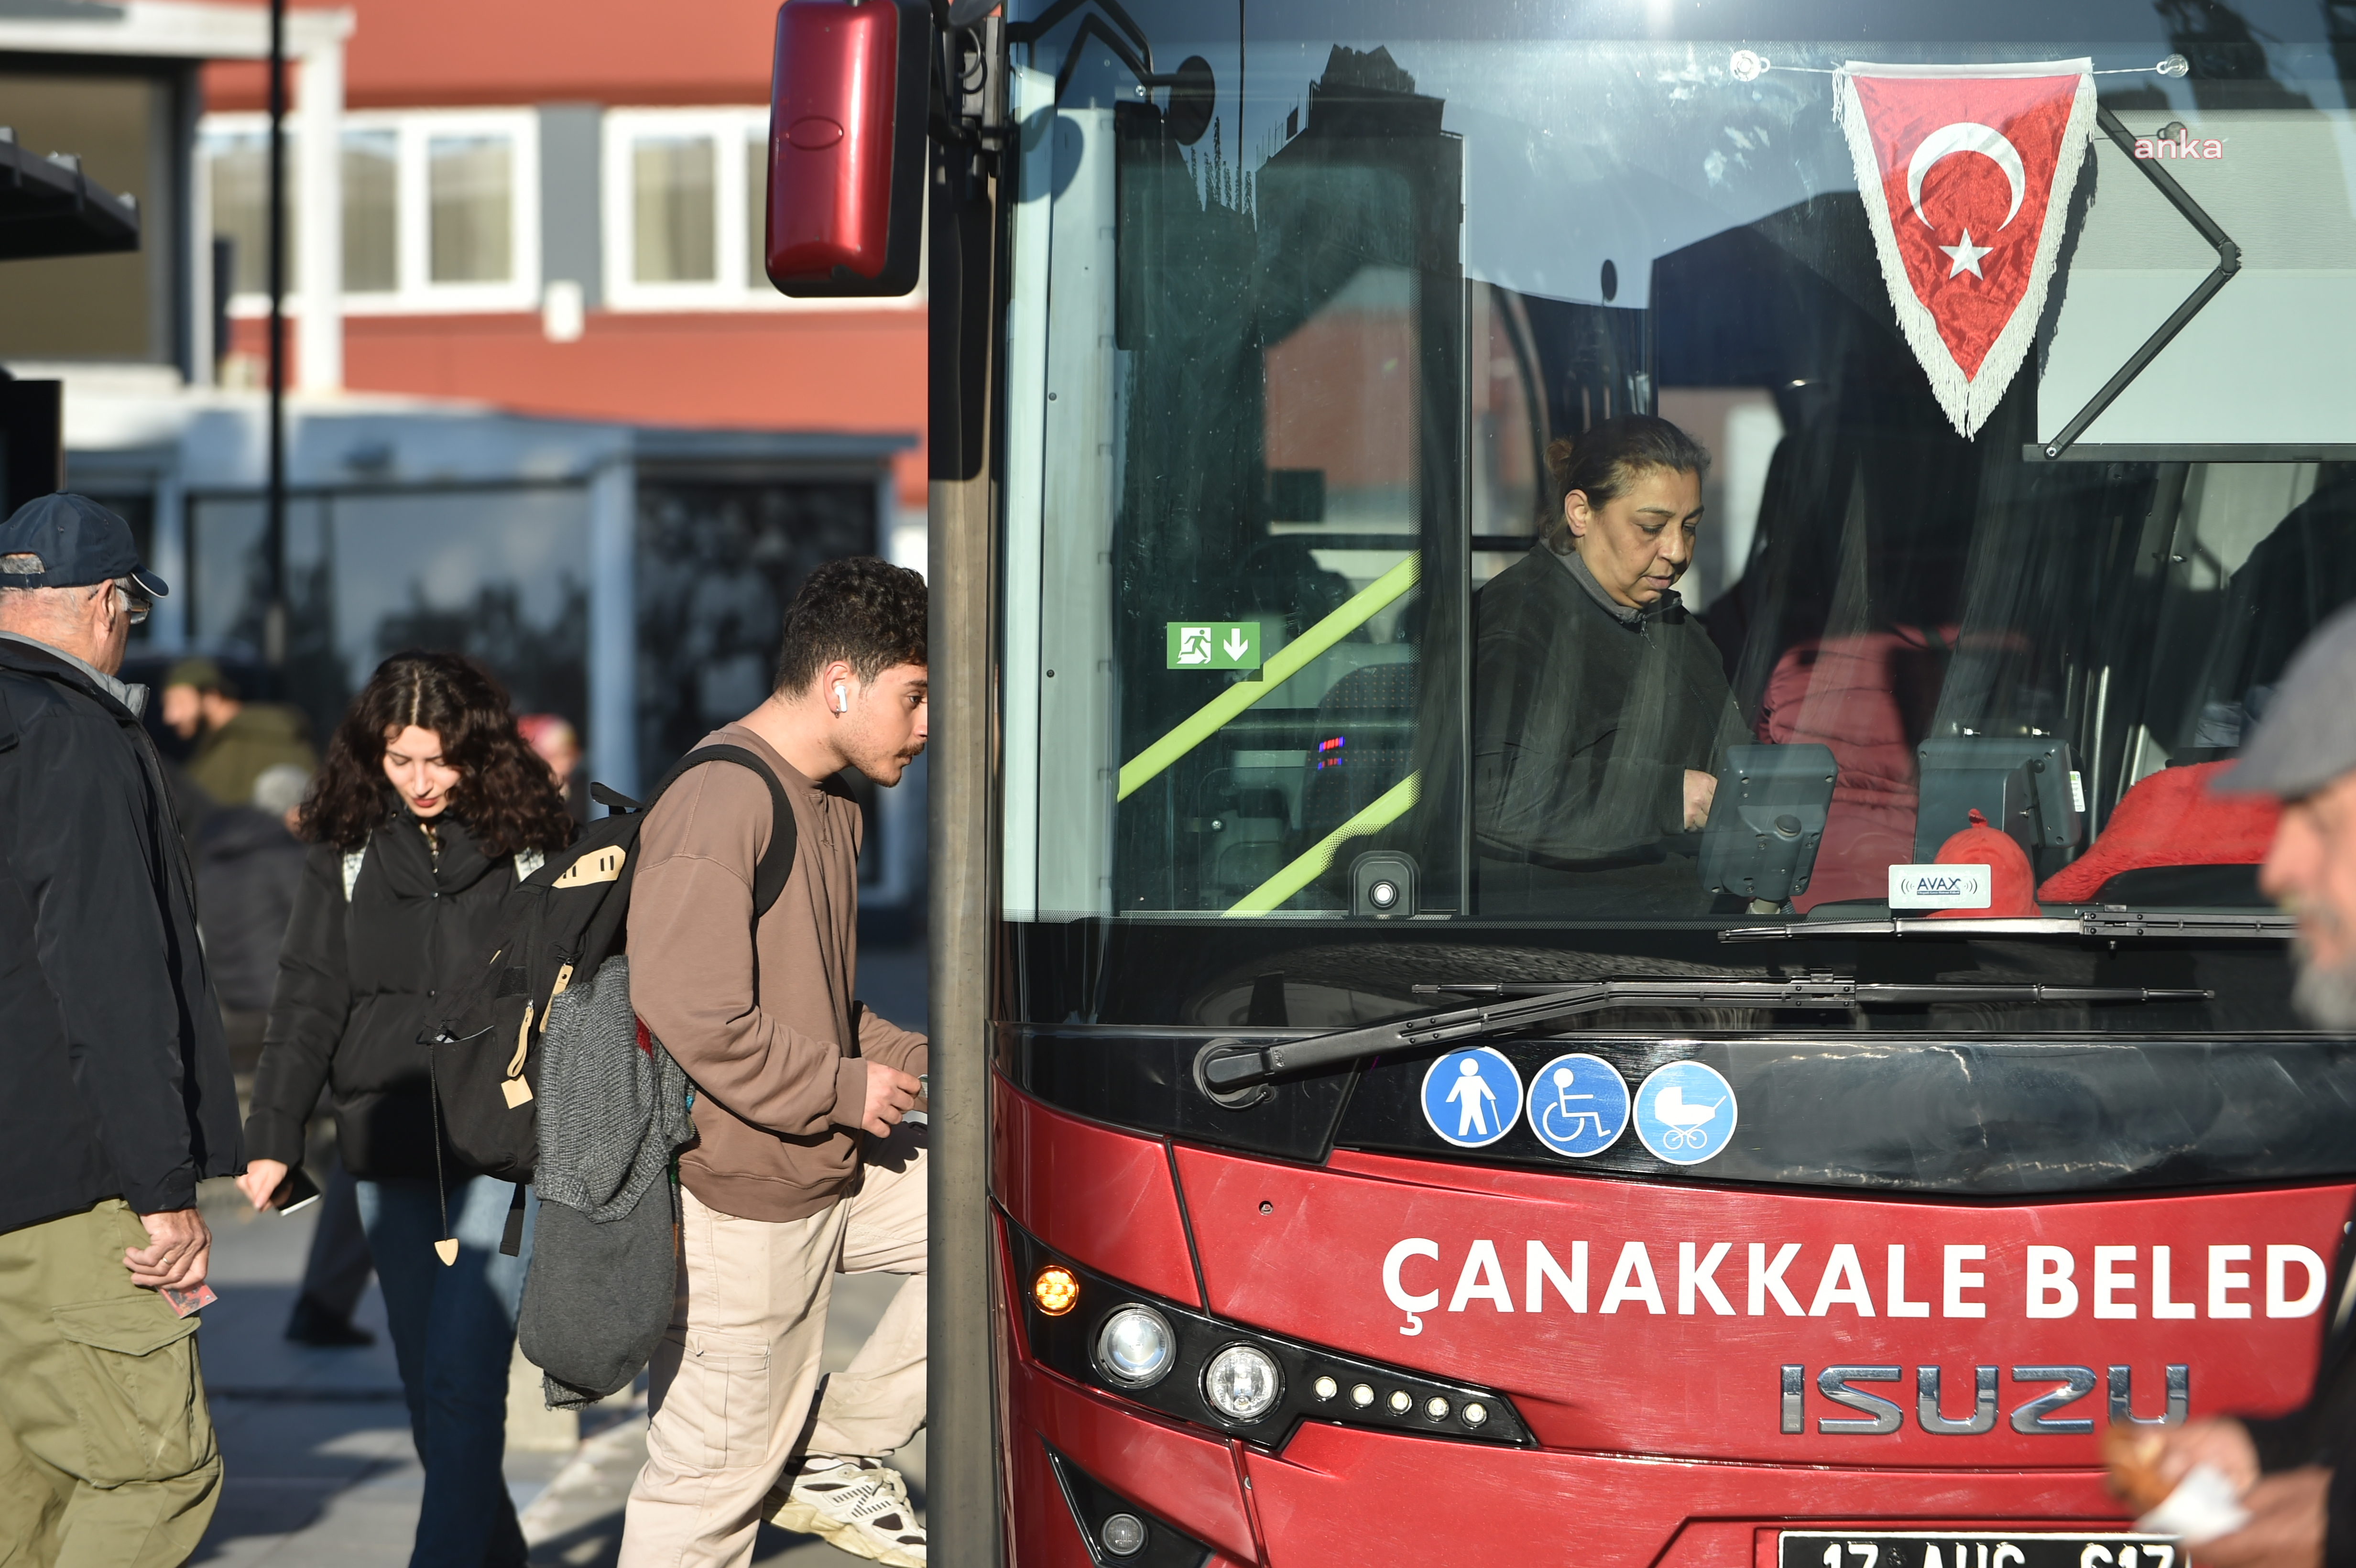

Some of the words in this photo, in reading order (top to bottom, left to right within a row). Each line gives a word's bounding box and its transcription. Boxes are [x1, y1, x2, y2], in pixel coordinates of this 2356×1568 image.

[1917, 877, 1962, 890] AVAX
[1382, 1238, 1986, 1335] ÇANAKKALE
[1780, 1364, 2189, 1434] ISUZU
